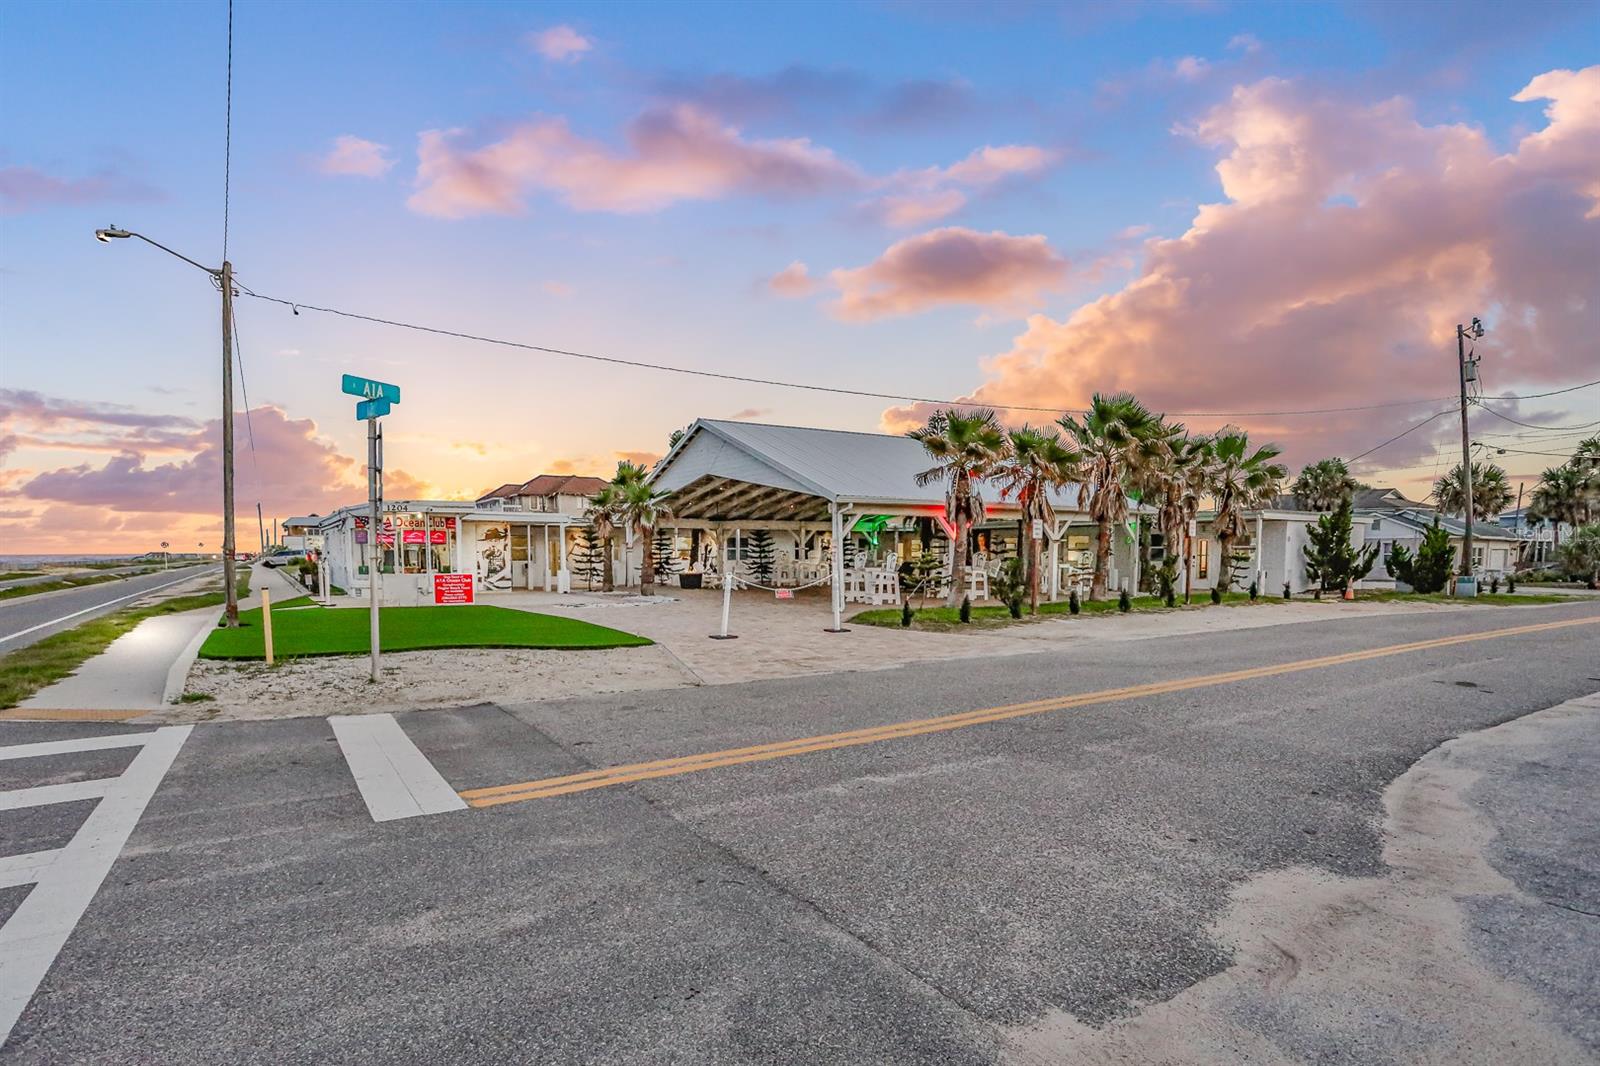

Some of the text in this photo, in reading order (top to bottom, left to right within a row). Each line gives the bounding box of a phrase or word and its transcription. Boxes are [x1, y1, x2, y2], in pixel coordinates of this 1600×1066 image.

[363, 381, 384, 398] A1A
[387, 504, 408, 512] 1204
[396, 517, 425, 528] Ocean
